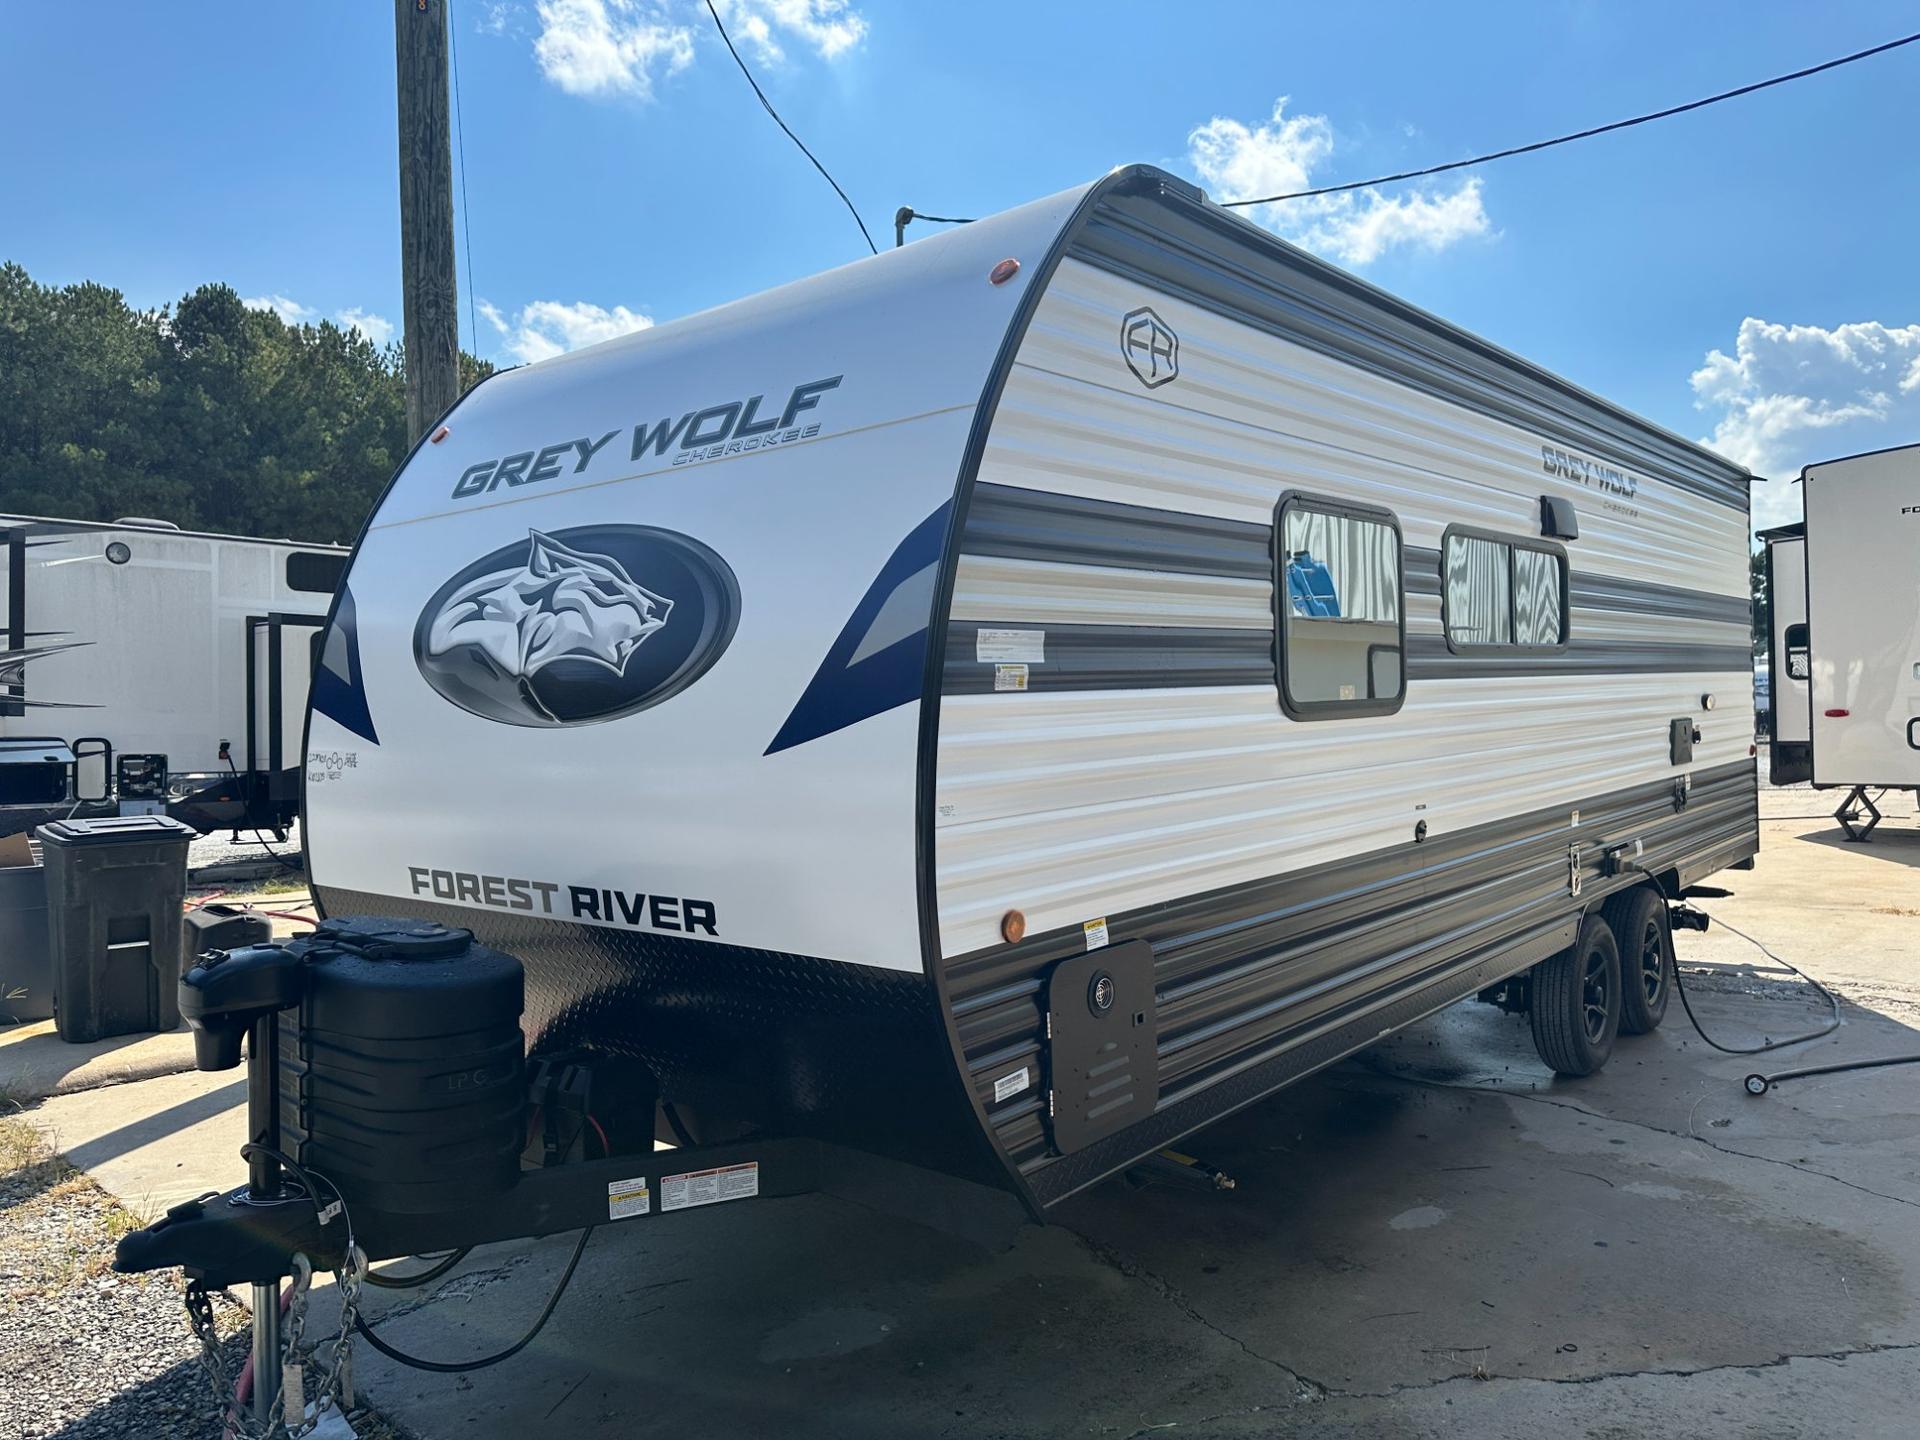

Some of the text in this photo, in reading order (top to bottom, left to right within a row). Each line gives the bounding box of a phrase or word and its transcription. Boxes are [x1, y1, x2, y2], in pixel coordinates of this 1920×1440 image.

[451, 374, 844, 500] GREY WOLF
[672, 422, 821, 466] CHEROKEE
[1542, 446, 1638, 499] GREY WOLF
[408, 866, 720, 937] FOREST RIVER
